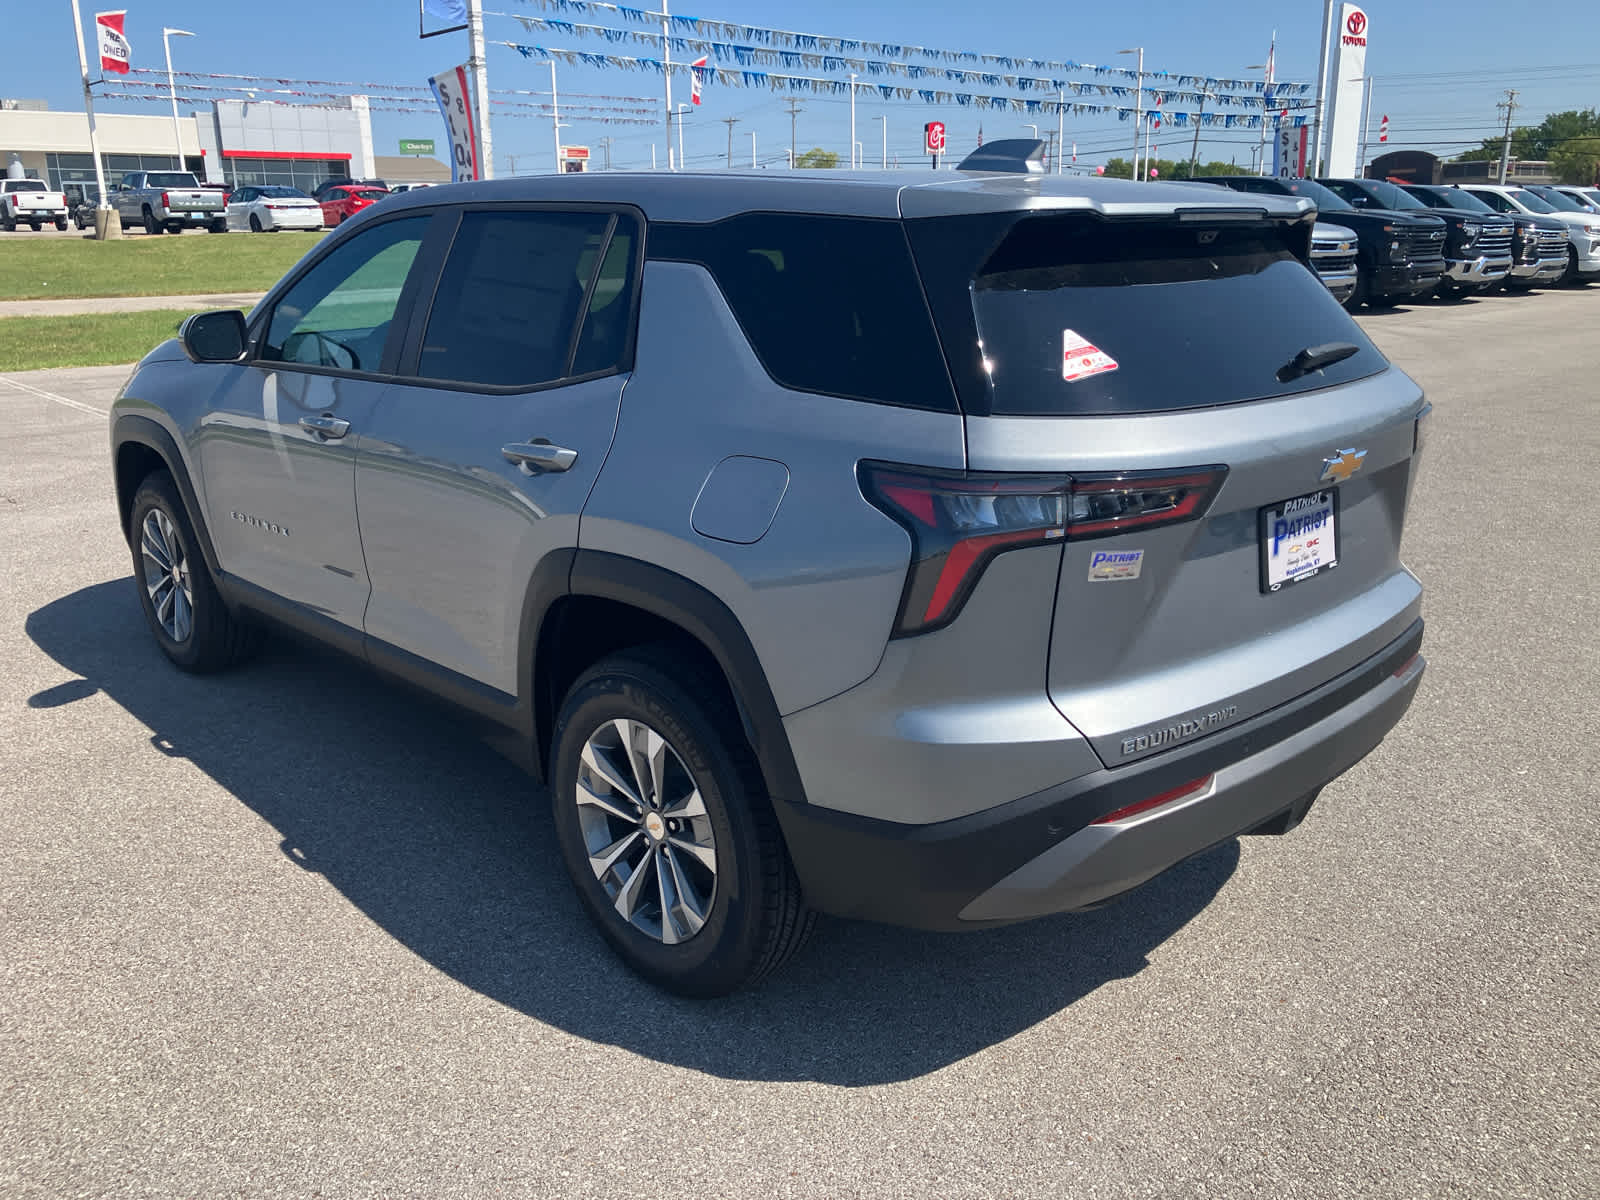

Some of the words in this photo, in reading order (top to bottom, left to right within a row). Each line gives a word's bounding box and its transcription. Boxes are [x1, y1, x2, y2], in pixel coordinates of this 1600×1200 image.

[1342, 35, 1366, 47] TOYOTA
[1284, 492, 1323, 516] PATRIOT
[230, 511, 290, 537] EQUINOX
[1273, 509, 1330, 557] PATRIOT
[1091, 551, 1143, 569] PATRIOT
[1121, 716, 1205, 755] EQUINOX
